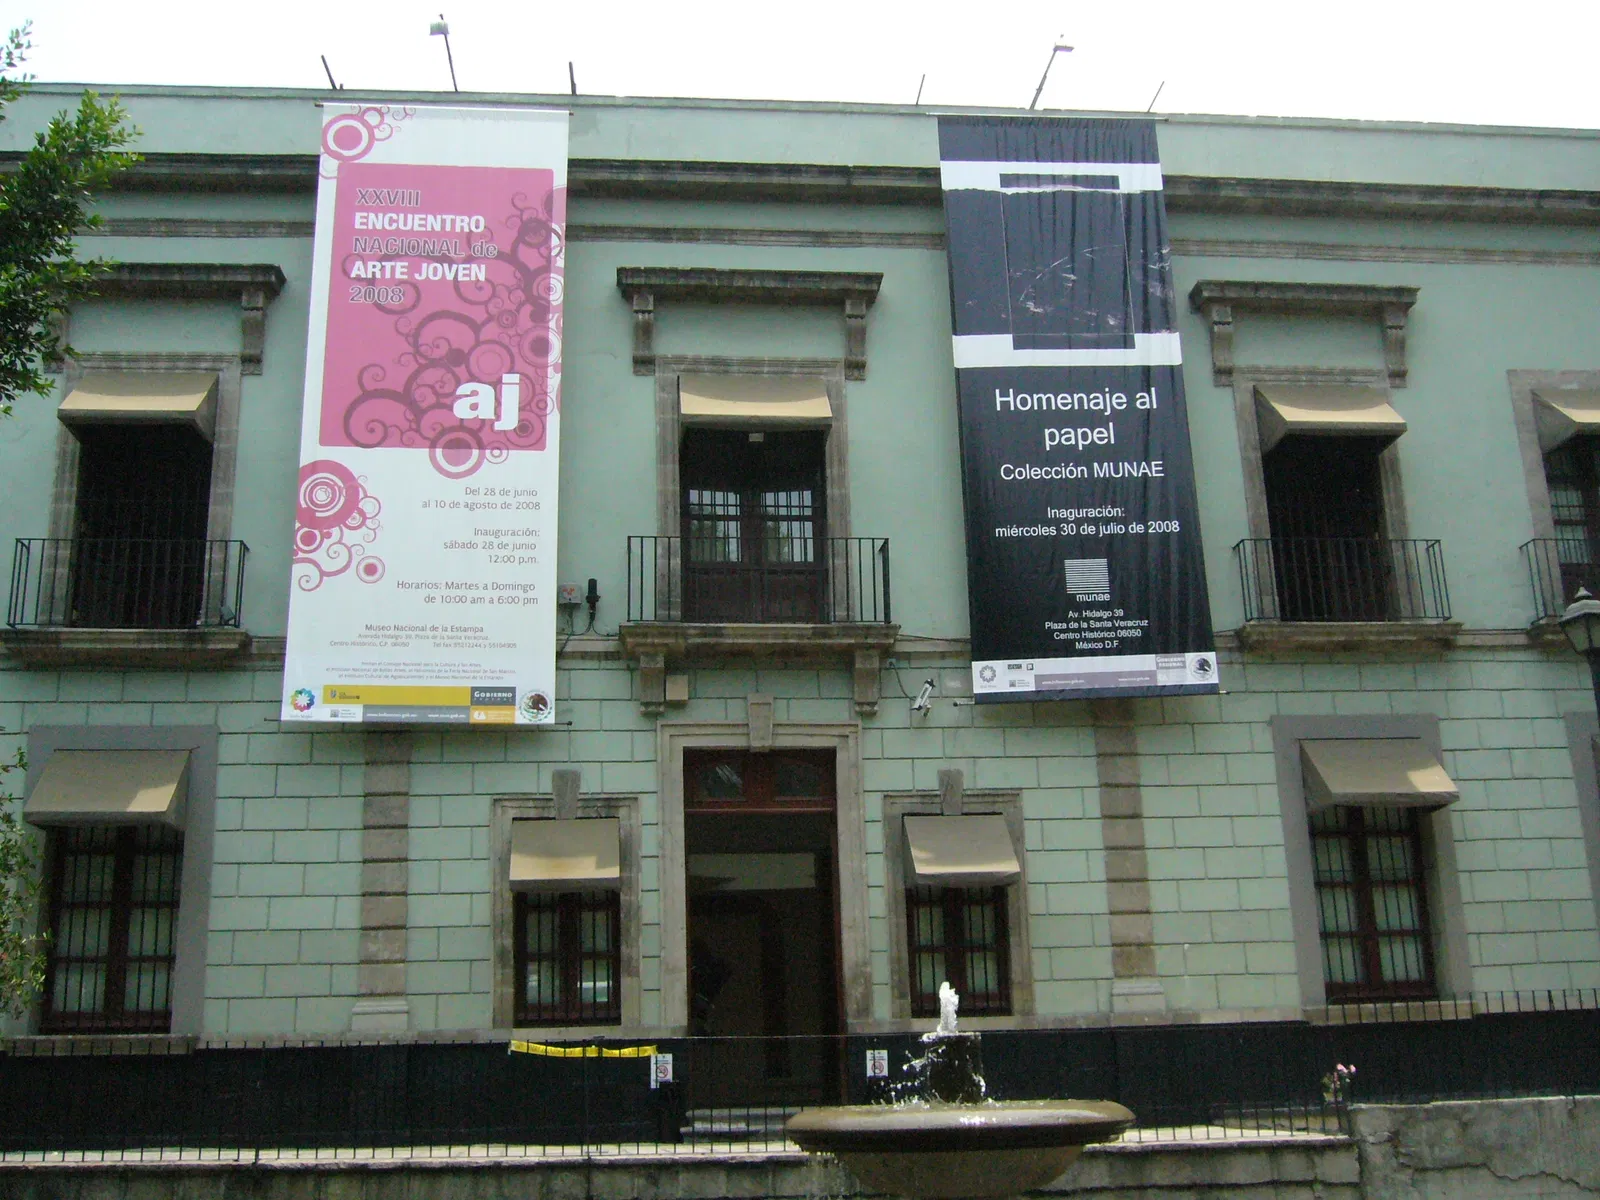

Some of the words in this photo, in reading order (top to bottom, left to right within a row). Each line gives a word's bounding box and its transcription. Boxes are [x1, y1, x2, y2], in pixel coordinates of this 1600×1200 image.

[356, 188, 421, 207] XXVIII
[354, 212, 485, 232] ENCUENTRO
[353, 237, 465, 256] NACIONAL
[471, 240, 498, 257] de
[350, 261, 408, 279] ARTE
[414, 263, 486, 281] JOVEN
[349, 286, 404, 303] 2008
[453, 373, 519, 430] aj
[995, 387, 1127, 415] Homenaje
[1135, 387, 1157, 409] al
[1045, 422, 1115, 451] papel
[1000, 463, 1088, 480] Colección
[1093, 461, 1164, 478] MUNAE
[465, 487, 480, 496] Del
[484, 487, 496, 496] 28
[499, 487, 511, 497] de
[513, 488, 538, 499] junio
[421, 500, 431, 508] al
[434, 500, 446, 509] 10
[449, 500, 461, 509] de
[464, 501, 498, 511] agosto
[500, 501, 512, 510] de
[515, 501, 541, 510] 2008
[1047, 505, 1125, 521] Inaguración:
[474, 528, 540, 539] Inauguración:
[995, 523, 1057, 537] miércoles
[1060, 523, 1076, 535] 30
[1080, 523, 1096, 535] de
[1099, 522, 1125, 537] julio
[1129, 521, 1145, 533] de
[1148, 520, 1180, 533] 2008
[443, 540, 478, 550] sábado
[482, 541, 494, 550] 28
[497, 541, 509, 550] de
[512, 542, 536, 553] junio
[488, 555, 515, 564] 12:00
[518, 557, 539, 565] p.m.
[397, 581, 442, 590] Horarios:
[445, 581, 479, 591] Martes
[491, 582, 535, 593] Domingo
[424, 595, 437, 604] de
[440, 595, 467, 604] 10:00
[497, 596, 520, 604] 6:00
[523, 597, 538, 606] pm
[1076, 592, 1110, 602] munae
[1082, 609, 1112, 618] Hidalgo
[1113, 609, 1124, 617] 39
[365, 624, 391, 632] Museo
[394, 624, 427, 632] Nacional
[450, 625, 484, 634] Estampa
[1045, 621, 1067, 630] Plaza
[1068, 620, 1079, 628] de
[1080, 620, 1088, 628] la
[1089, 620, 1112, 628] Santa
[1113, 619, 1148, 627] Veracruz
[1054, 631, 1080, 640] Centro
[1082, 629, 1116, 639] Histórico
[1117, 629, 1142, 638] 06050
[1075, 640, 1103, 649] México
